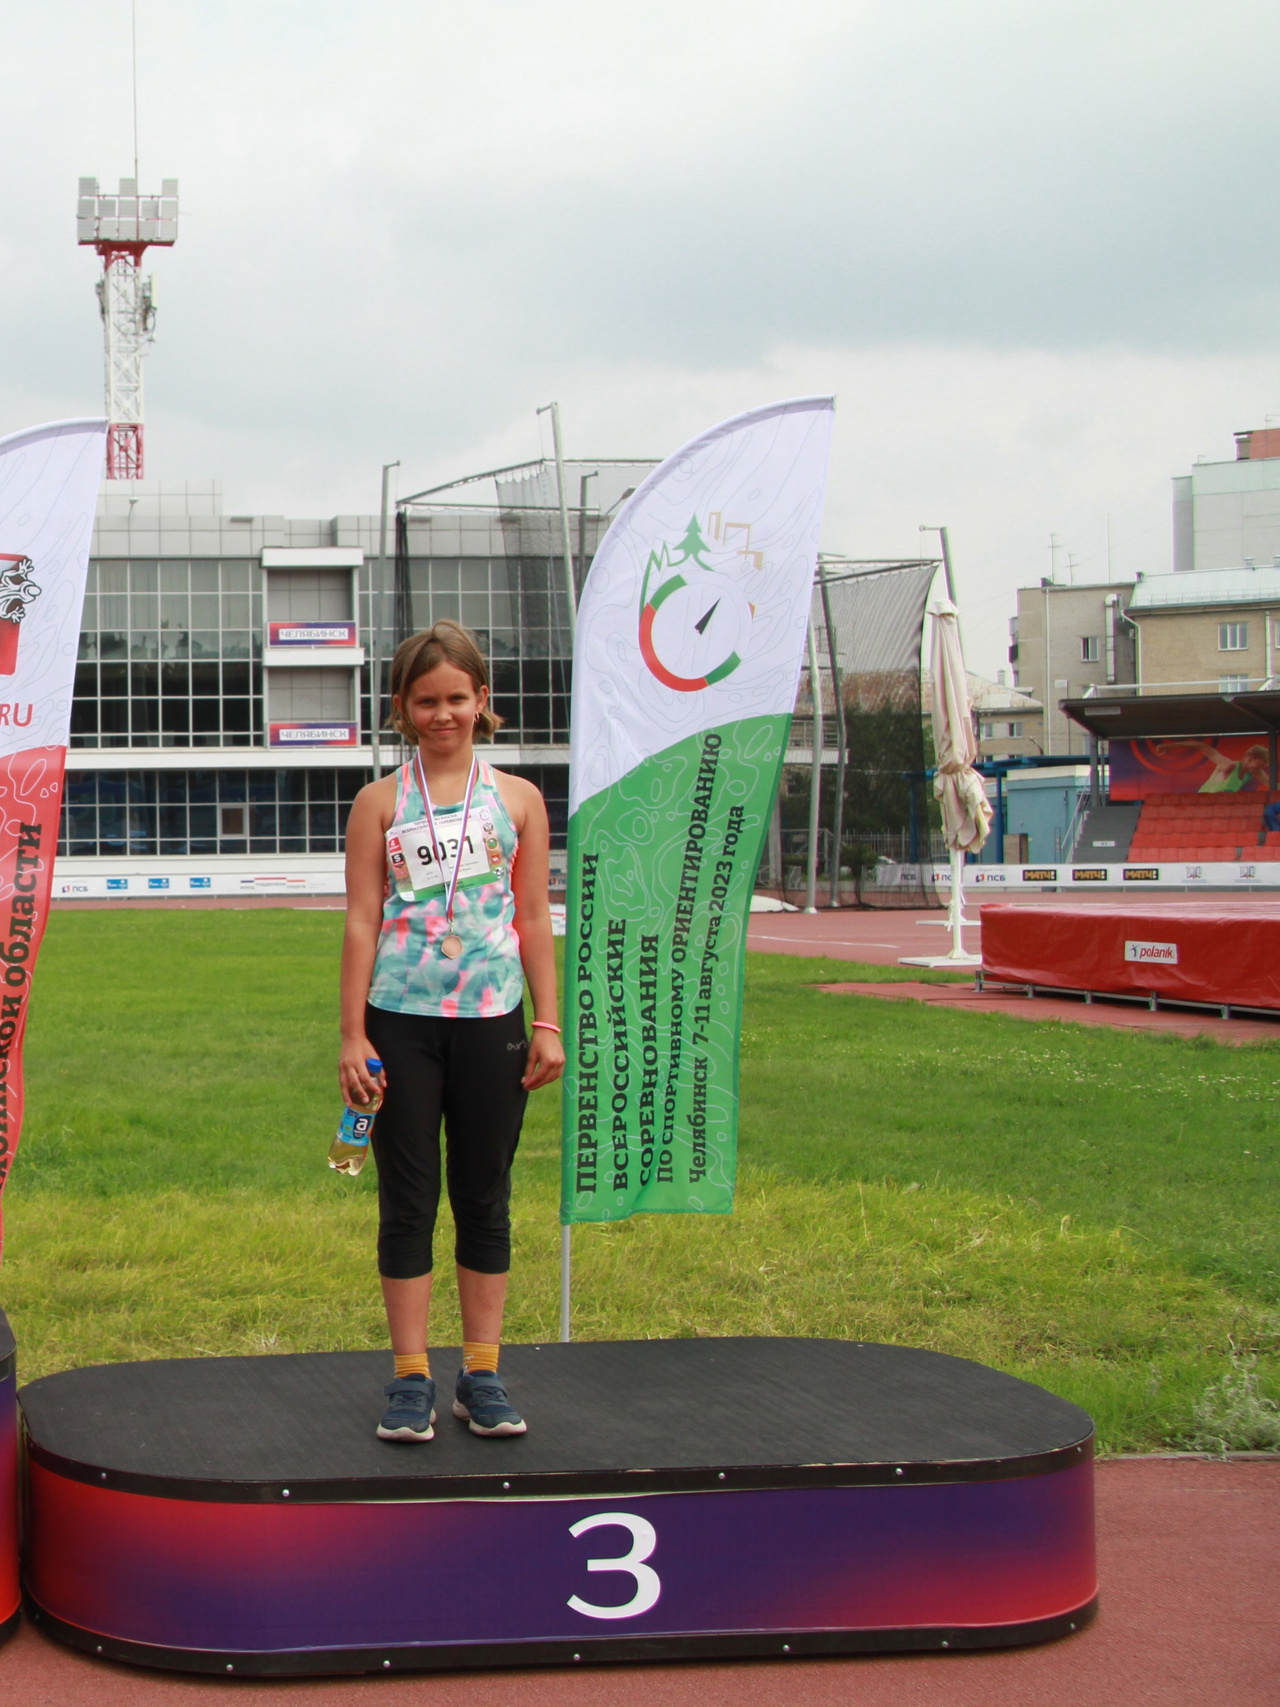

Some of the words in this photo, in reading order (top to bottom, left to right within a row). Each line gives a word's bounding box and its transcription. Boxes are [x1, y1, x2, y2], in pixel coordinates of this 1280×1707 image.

[280, 629, 348, 638] ЧЕЛЯБИНСК
[281, 729, 348, 738] ЧЕЛЯБИНСК
[417, 835, 474, 866] 9031
[671, 733, 722, 963] ОРИЕНТИРОВАНИЮ
[722, 805, 746, 857] года
[577, 852, 599, 983] РОССИИ
[708, 860, 733, 912] 2023
[698, 915, 722, 1000] августа
[1139, 945, 1173, 959] polanik
[606, 919, 630, 1191] ВСЕРОССИЙСКИЕ
[639, 934, 659, 1187] СОРЕВНОВАНИЯ
[661, 967, 685, 1145] СПОРТИВНОМУ
[691, 1004, 711, 1045] 7-11
[576, 989, 599, 1194] ПЕРВЕНСТВО
[686, 1056, 709, 1183] Челябинск
[656, 1149, 673, 1183] ПО
[566, 1511, 661, 1619] 3
